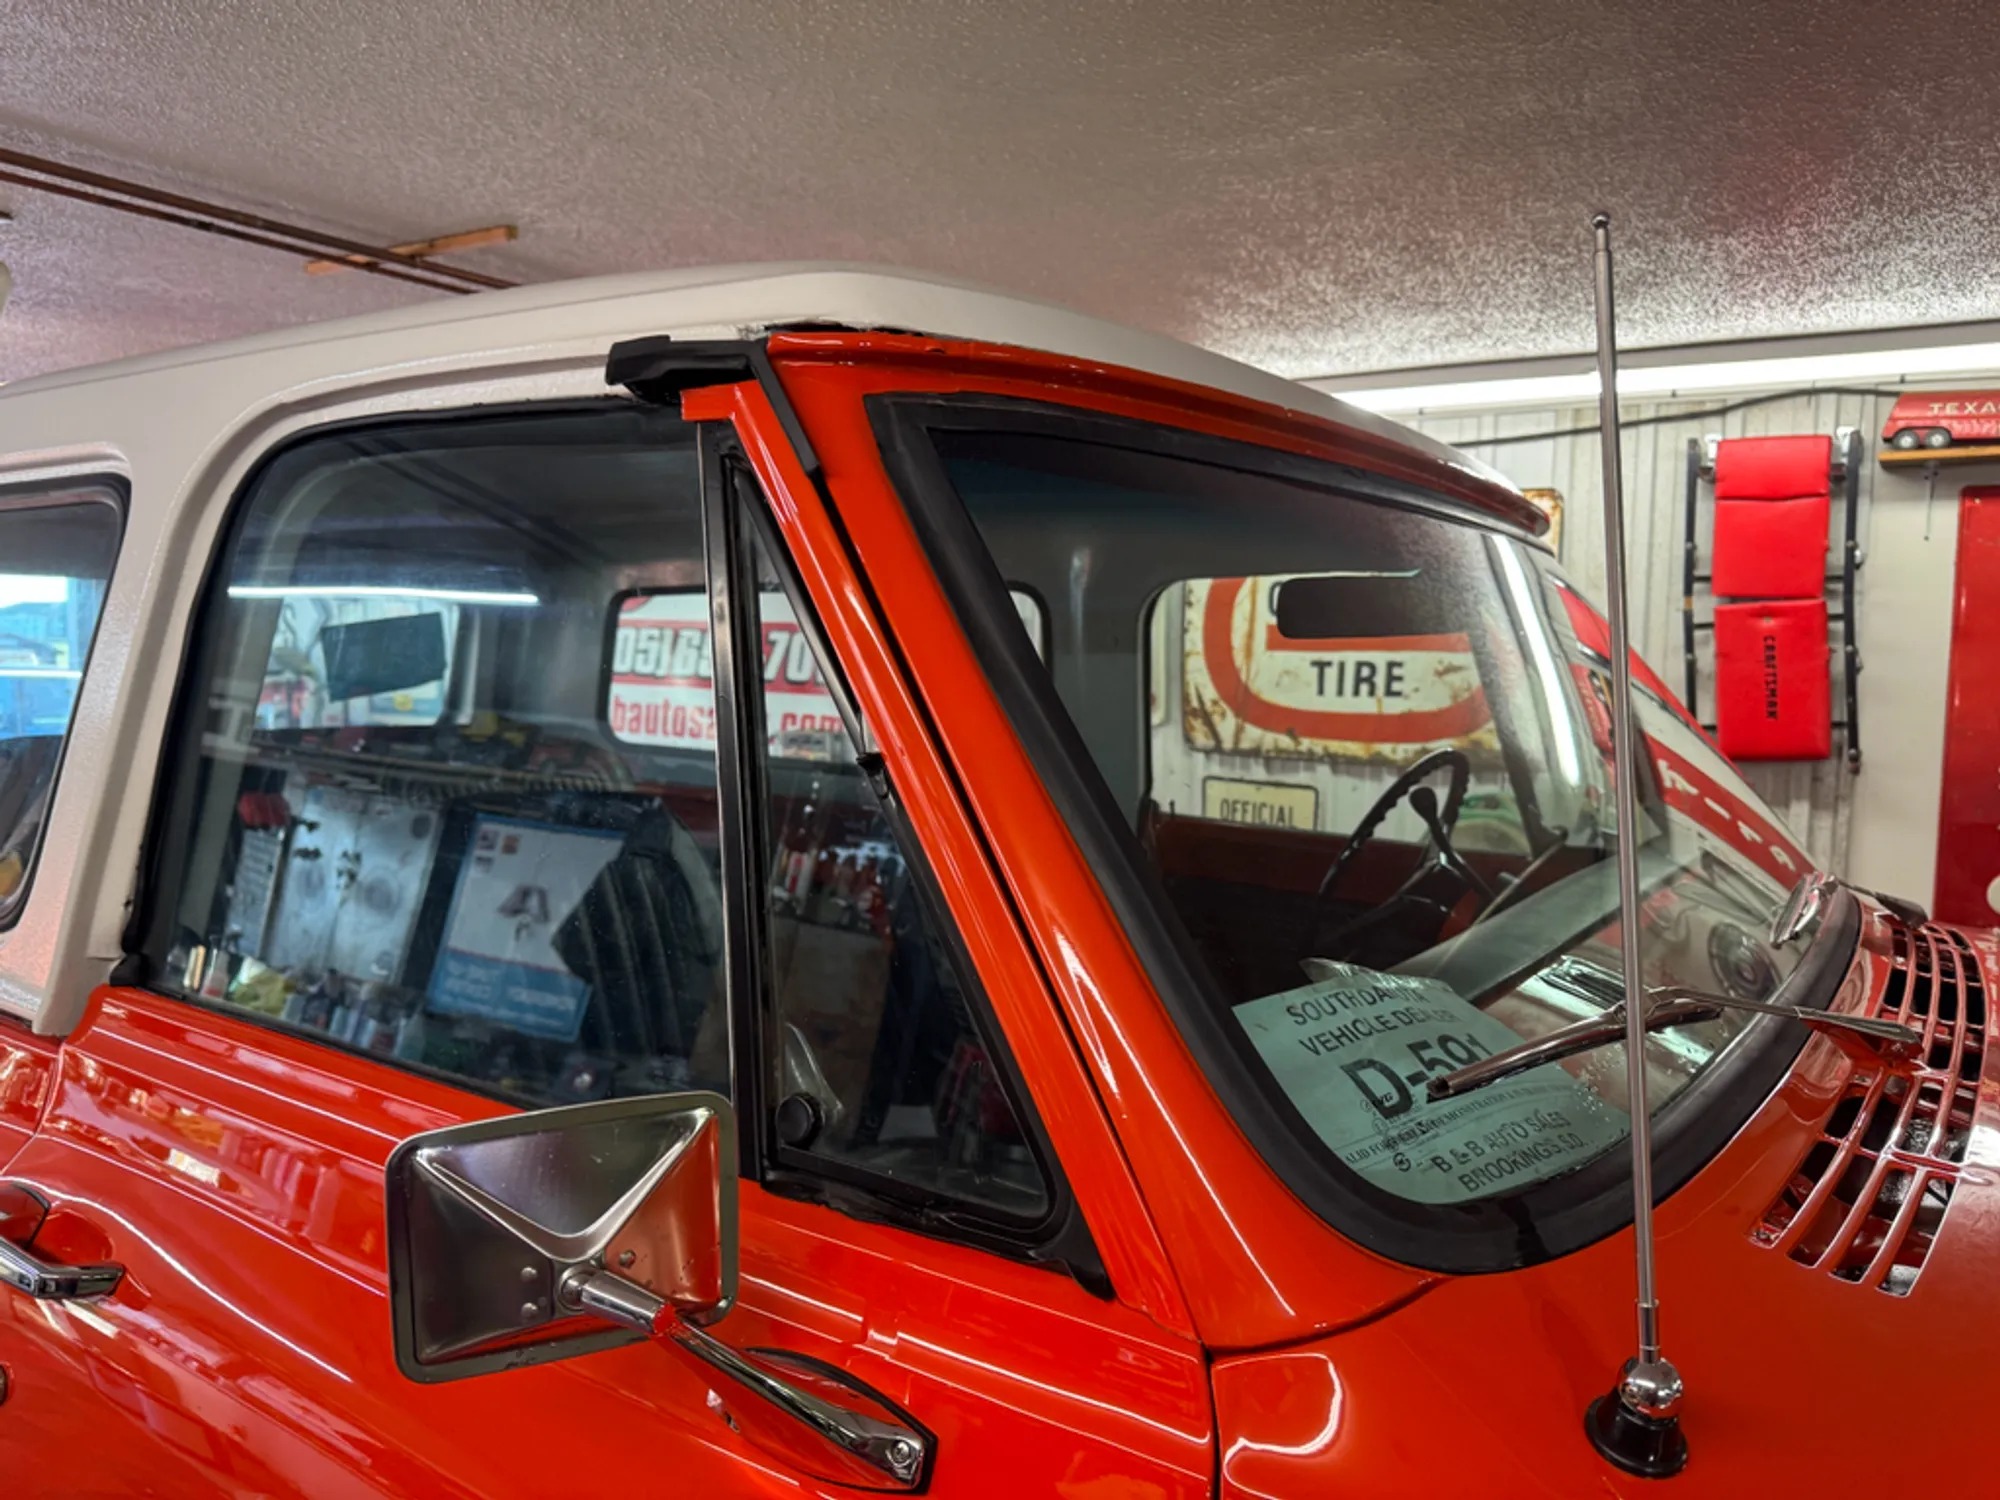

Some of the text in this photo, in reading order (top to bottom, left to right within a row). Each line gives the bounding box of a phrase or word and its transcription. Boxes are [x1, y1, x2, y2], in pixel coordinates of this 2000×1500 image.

[1928, 401, 2000, 416] TEXA
[1310, 660, 1405, 698] TIRE
[1763, 635, 1778, 720] CRAFTSMAN
[1220, 798, 1296, 831] OFFICIAL
[1286, 988, 1364, 1027] SOUTH
[1298, 1014, 1399, 1057] VEHICLE
[1430, 1155, 1453, 1174] B
[1450, 1147, 1472, 1166] &
[1464, 1140, 1485, 1158] B
[1483, 1120, 1530, 1151] AUTO
[1527, 1108, 1573, 1133] SALES
